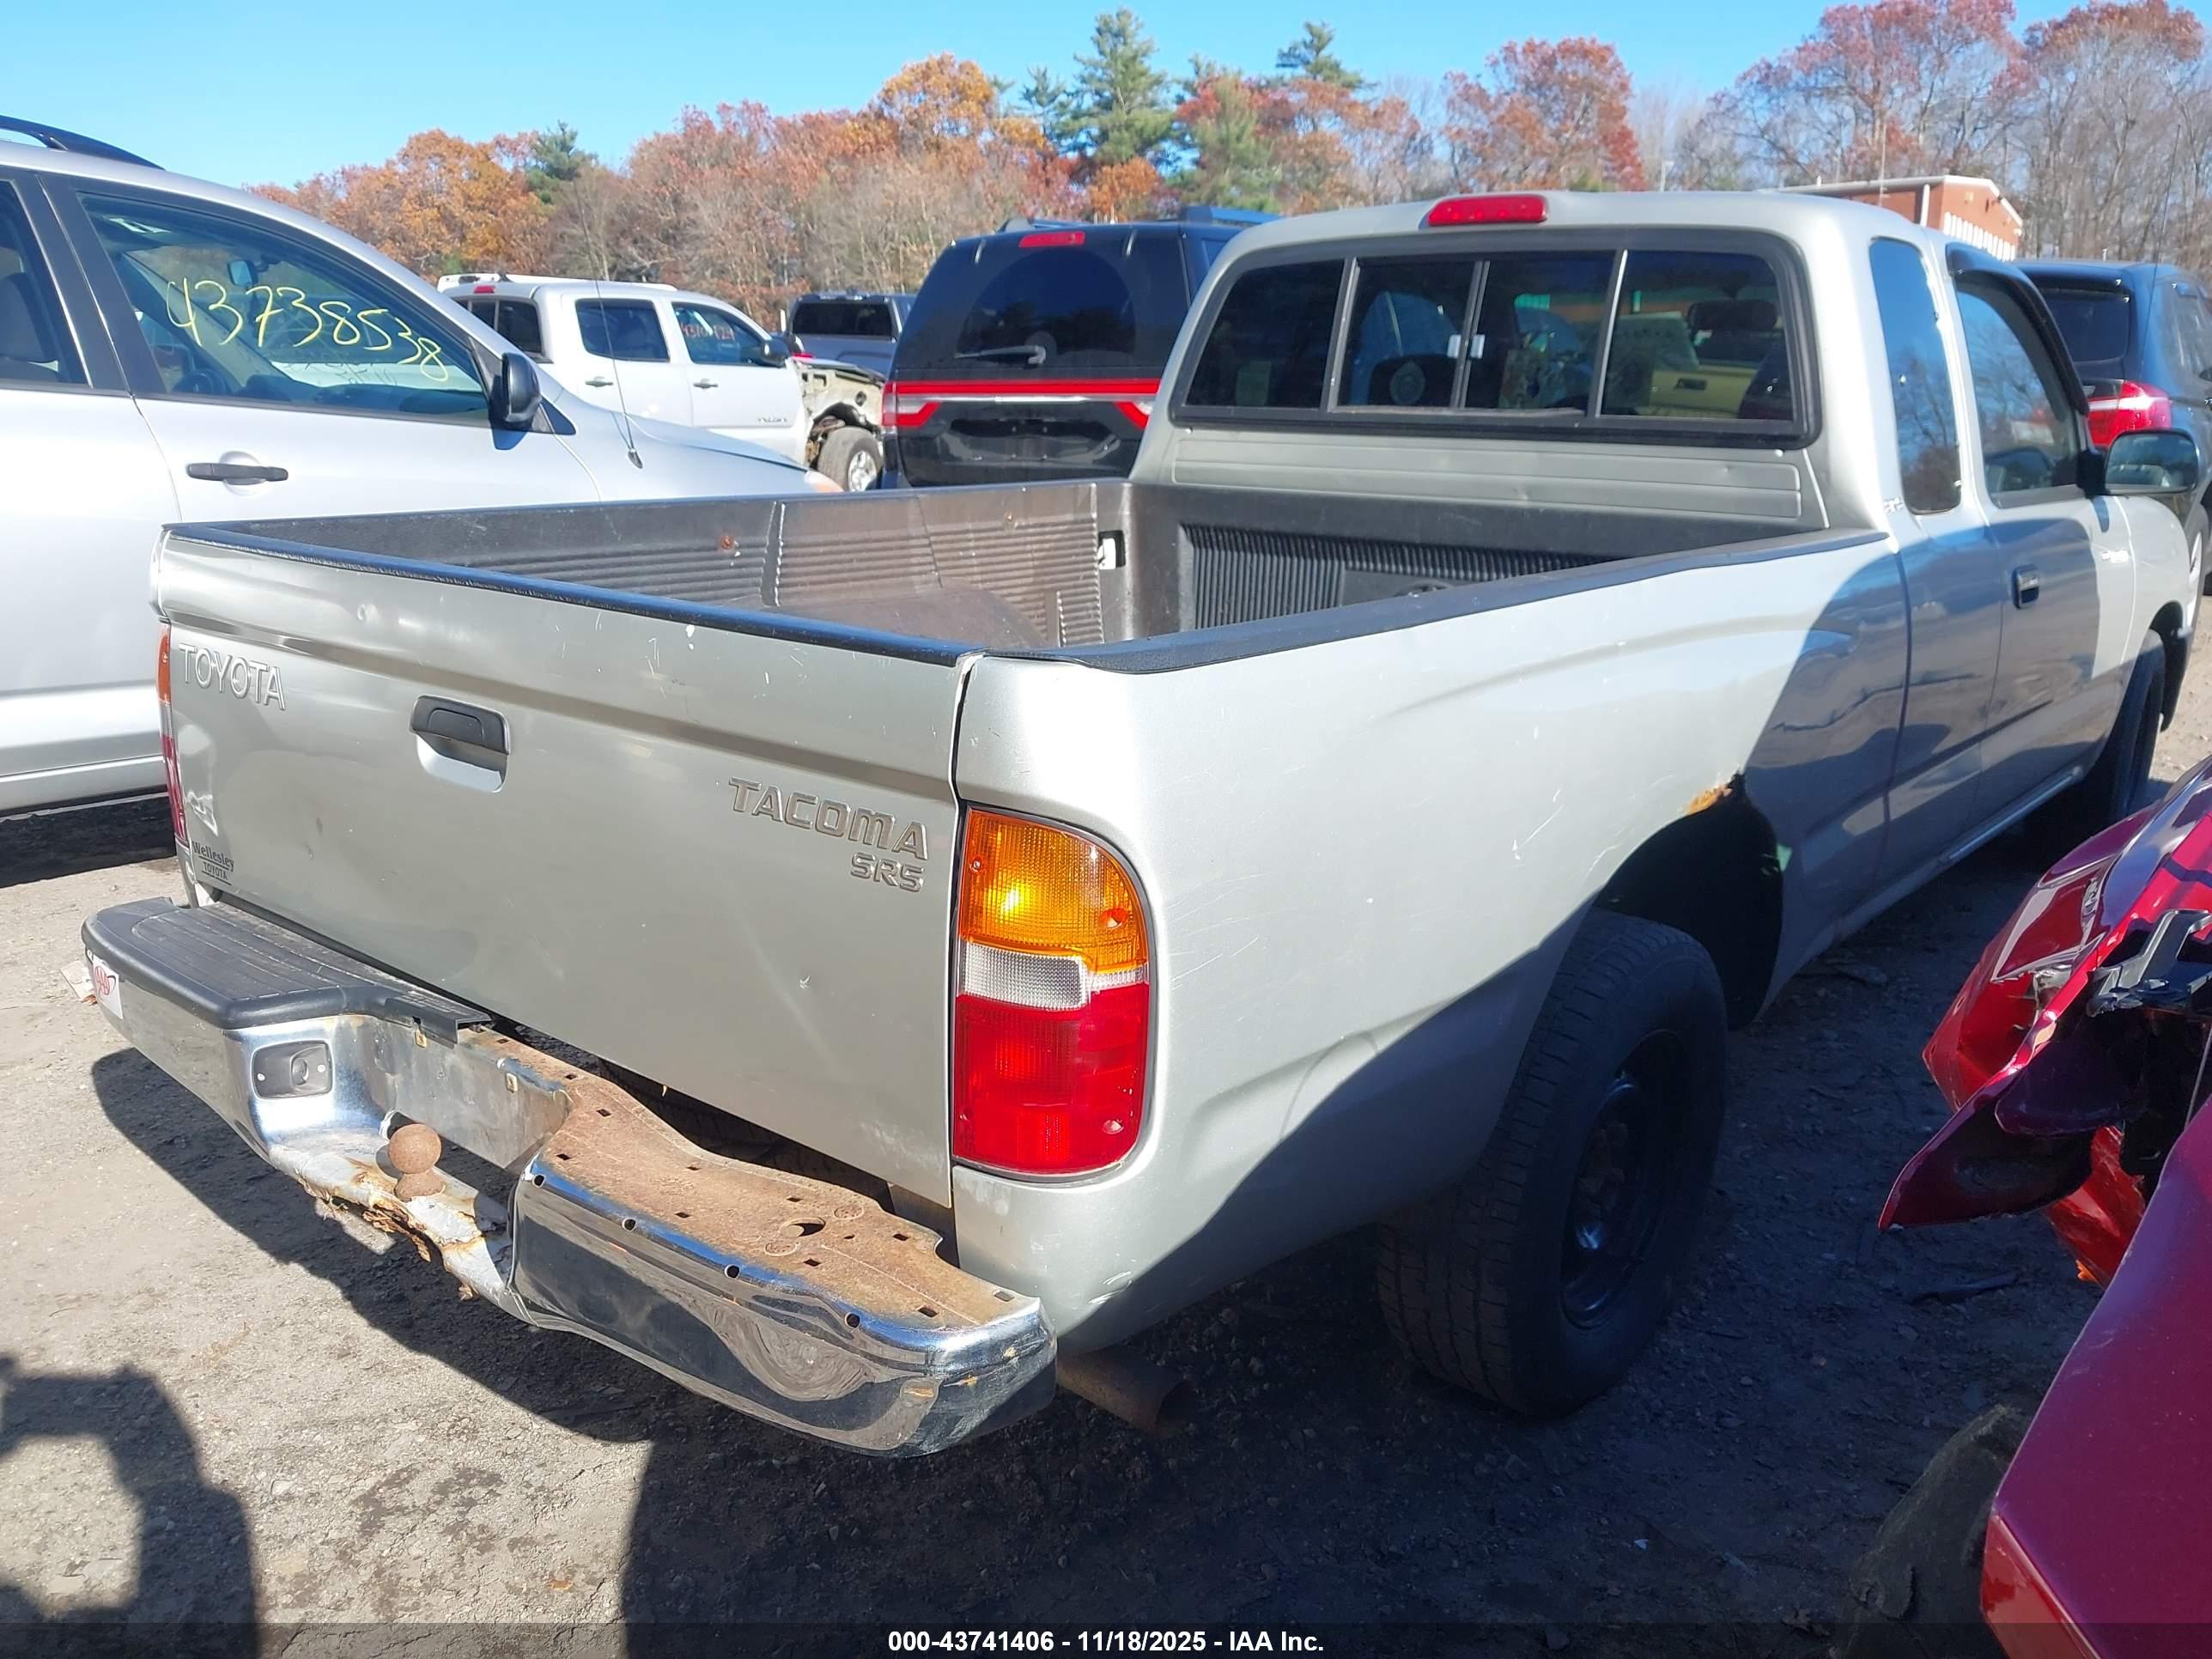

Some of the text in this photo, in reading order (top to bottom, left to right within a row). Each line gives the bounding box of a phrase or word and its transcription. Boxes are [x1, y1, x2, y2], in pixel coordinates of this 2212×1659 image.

[166, 276, 448, 381] 43738538
[178, 642, 286, 711] TOYOTA
[729, 776, 928, 860] TACOMA
[191, 841, 234, 872] Wellesley
[203, 861, 228, 879] TOYOTA
[850, 852, 924, 892] SRS
